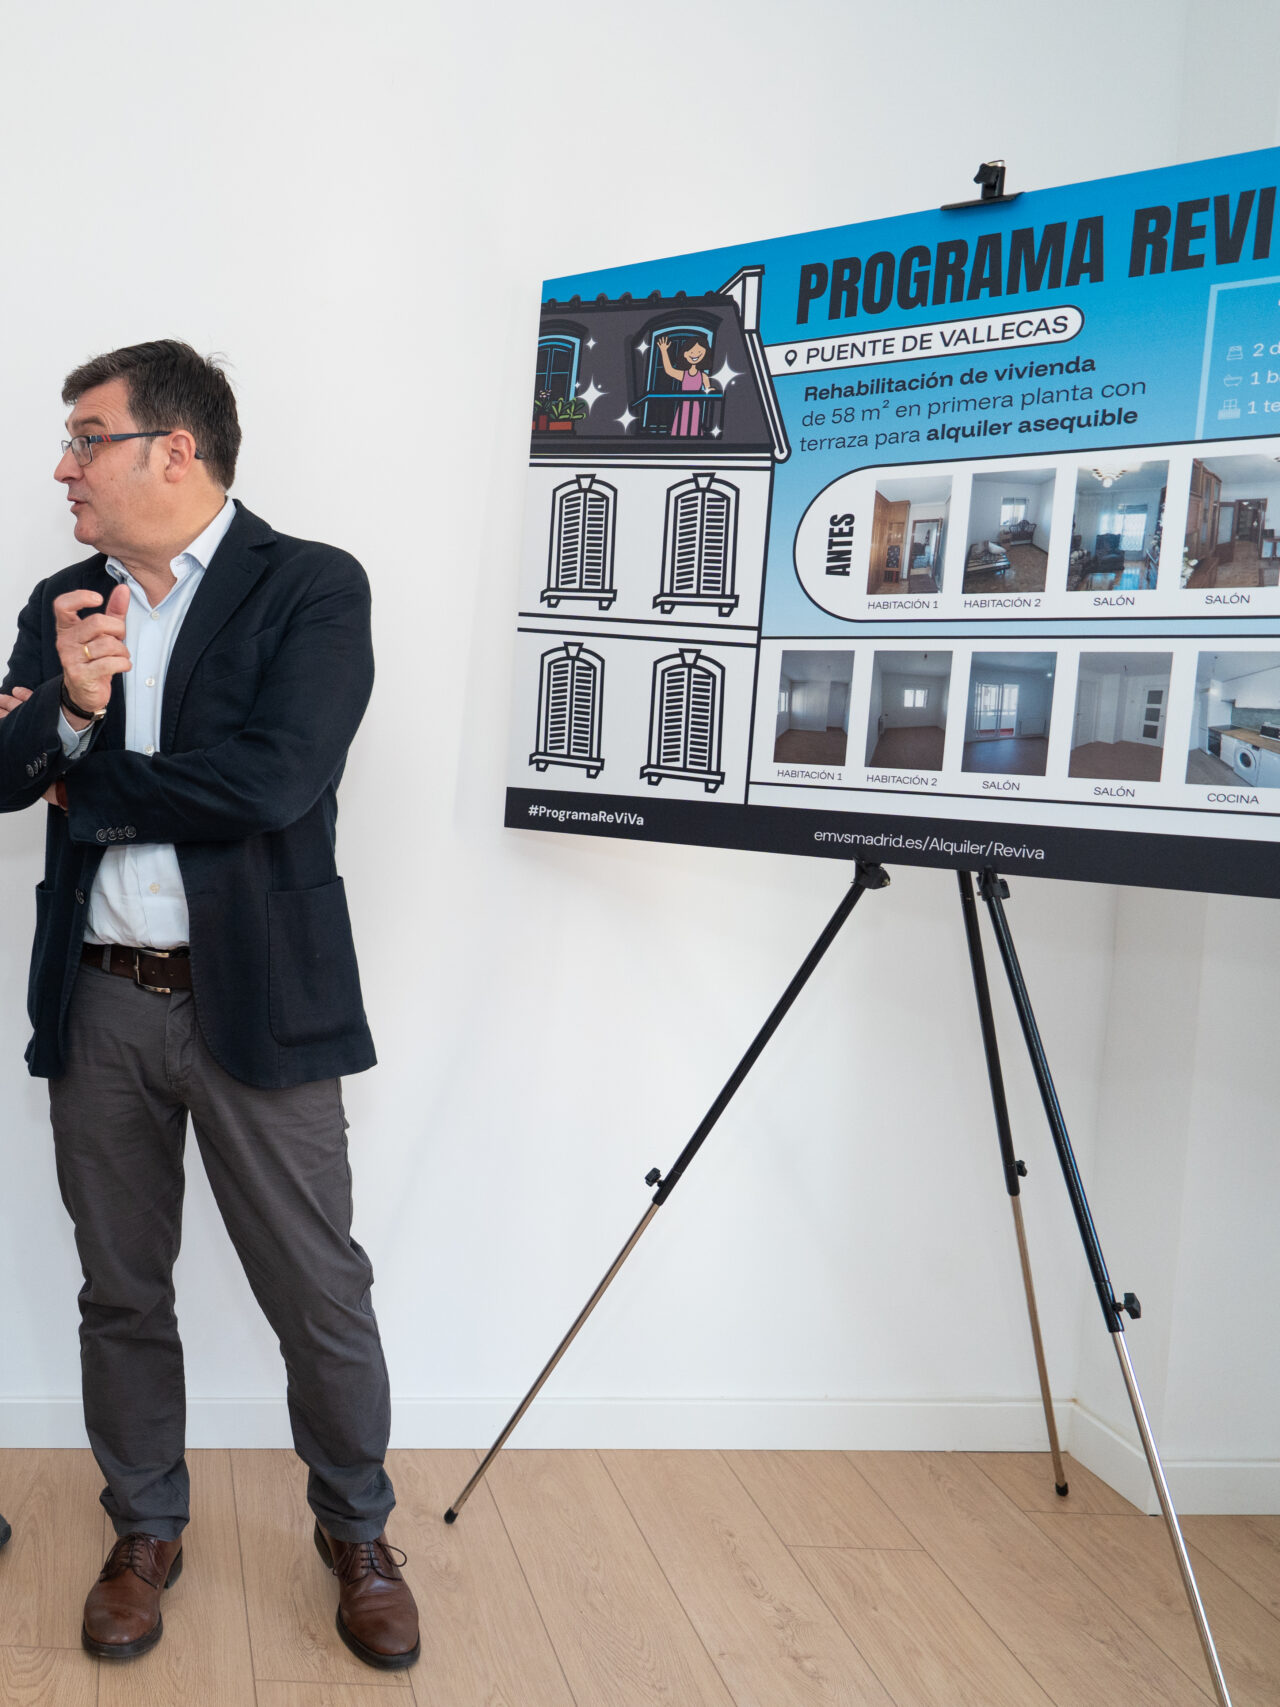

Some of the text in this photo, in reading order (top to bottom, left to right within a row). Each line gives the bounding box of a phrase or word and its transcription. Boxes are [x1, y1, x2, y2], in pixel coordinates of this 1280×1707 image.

[795, 186, 1277, 325] PROGRAMA REVI
[806, 315, 1069, 365] PUENTE DE VALLECAS
[1252, 343, 1264, 357] 2
[804, 355, 1096, 402] Rehabilitación de vivienda
[1250, 371, 1261, 385] 1
[802, 410, 826, 427] de
[831, 407, 855, 424] 58
[895, 404, 921, 417] en
[927, 393, 1014, 418] primera
[1020, 384, 1094, 408] planta
[1101, 379, 1147, 399] con
[1247, 401, 1257, 414] 1
[799, 407, 1138, 452] terraza para alquiler asequible
[825, 512, 855, 577] ANTES
[867, 599, 939, 610] HABITACIÓN 1
[963, 597, 1042, 609] HABITACIÓN 2
[1093, 593, 1135, 606] SALÓN
[1204, 592, 1251, 605] SALÓN
[777, 769, 835, 780] HABITACIÓN
[866, 774, 938, 787] HABITACIÓN 2
[982, 778, 1020, 791] SALÓN
[1093, 784, 1136, 798] SALÓN
[1207, 792, 1260, 805] COCINA
[528, 804, 644, 826] #ProgramaReViVa
[814, 827, 1045, 861] emvsmadrid.es/Alquiler/Reviva
